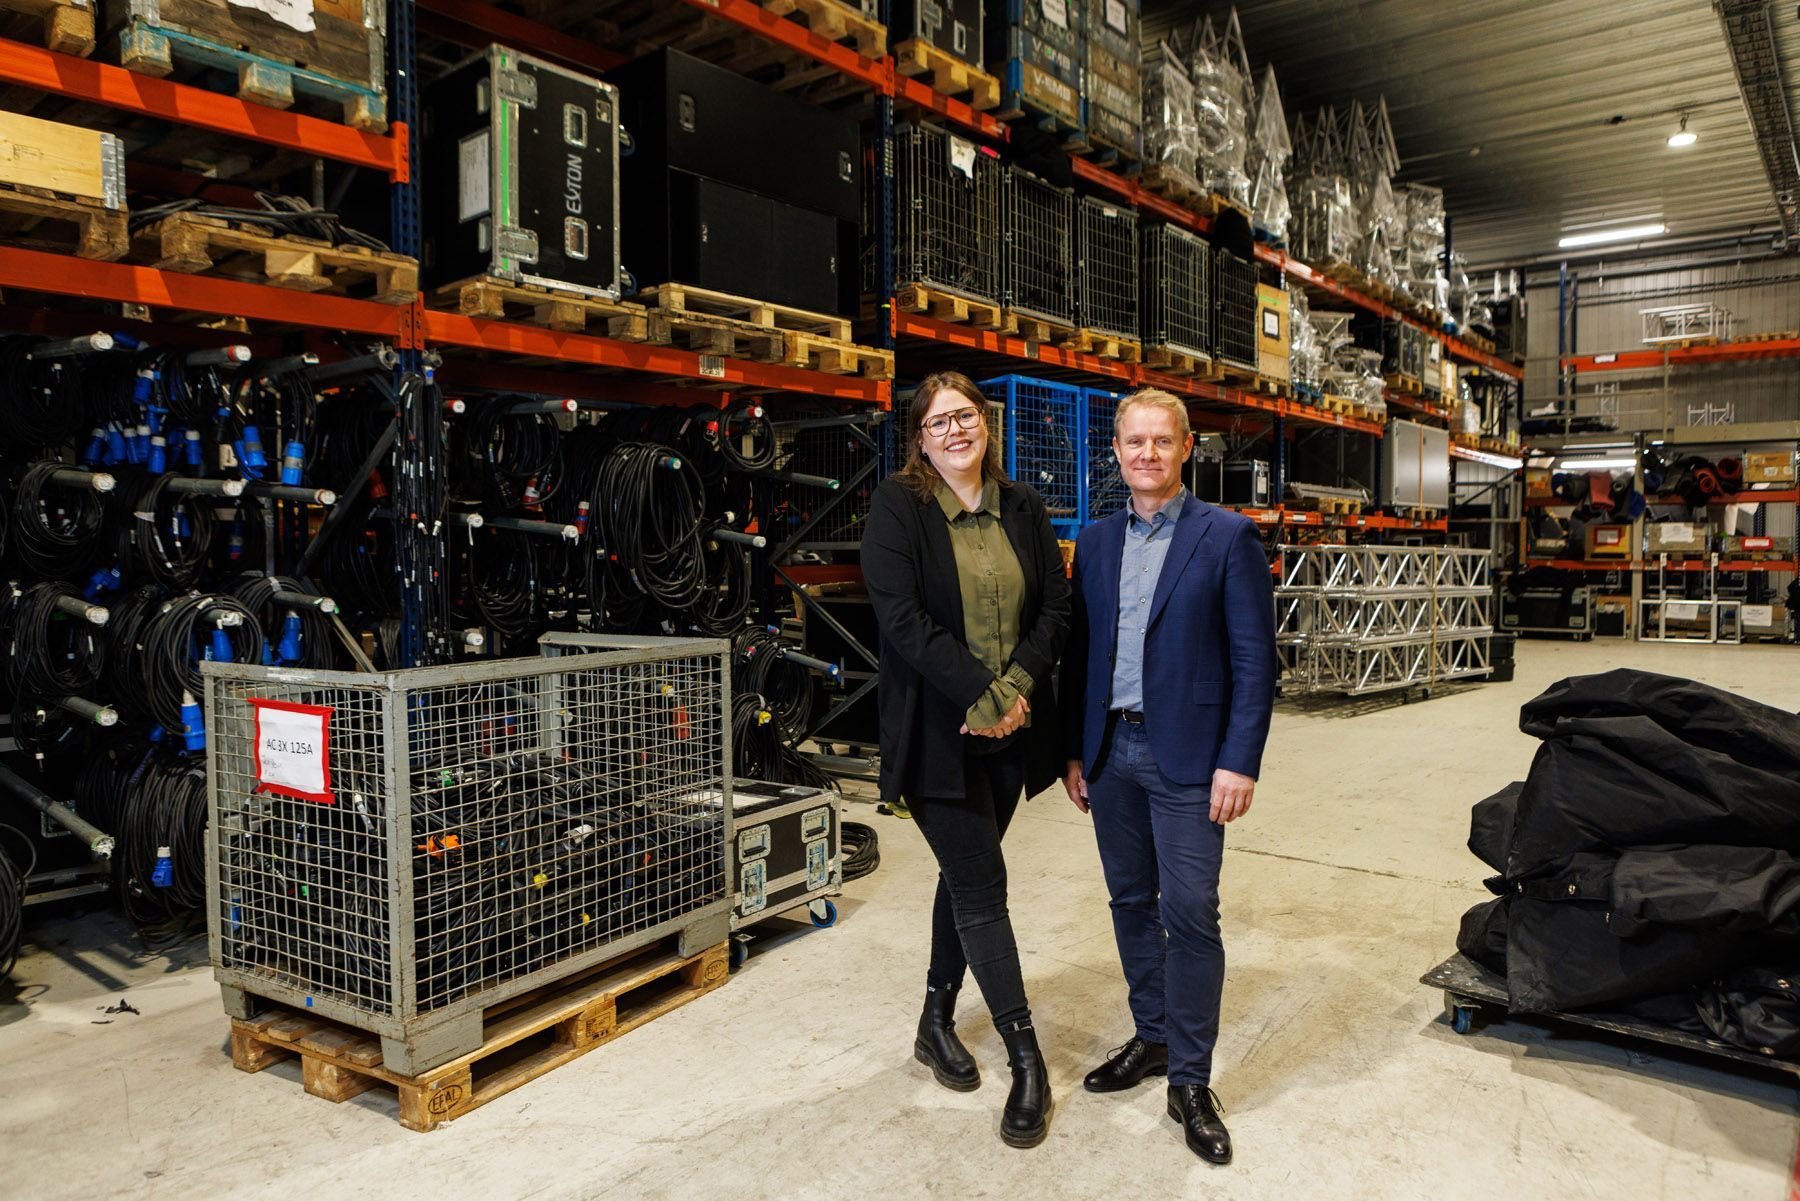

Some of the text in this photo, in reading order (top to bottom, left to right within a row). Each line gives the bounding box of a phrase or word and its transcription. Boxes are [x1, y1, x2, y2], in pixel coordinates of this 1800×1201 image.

[266, 738, 313, 755] AC 3X 125A
